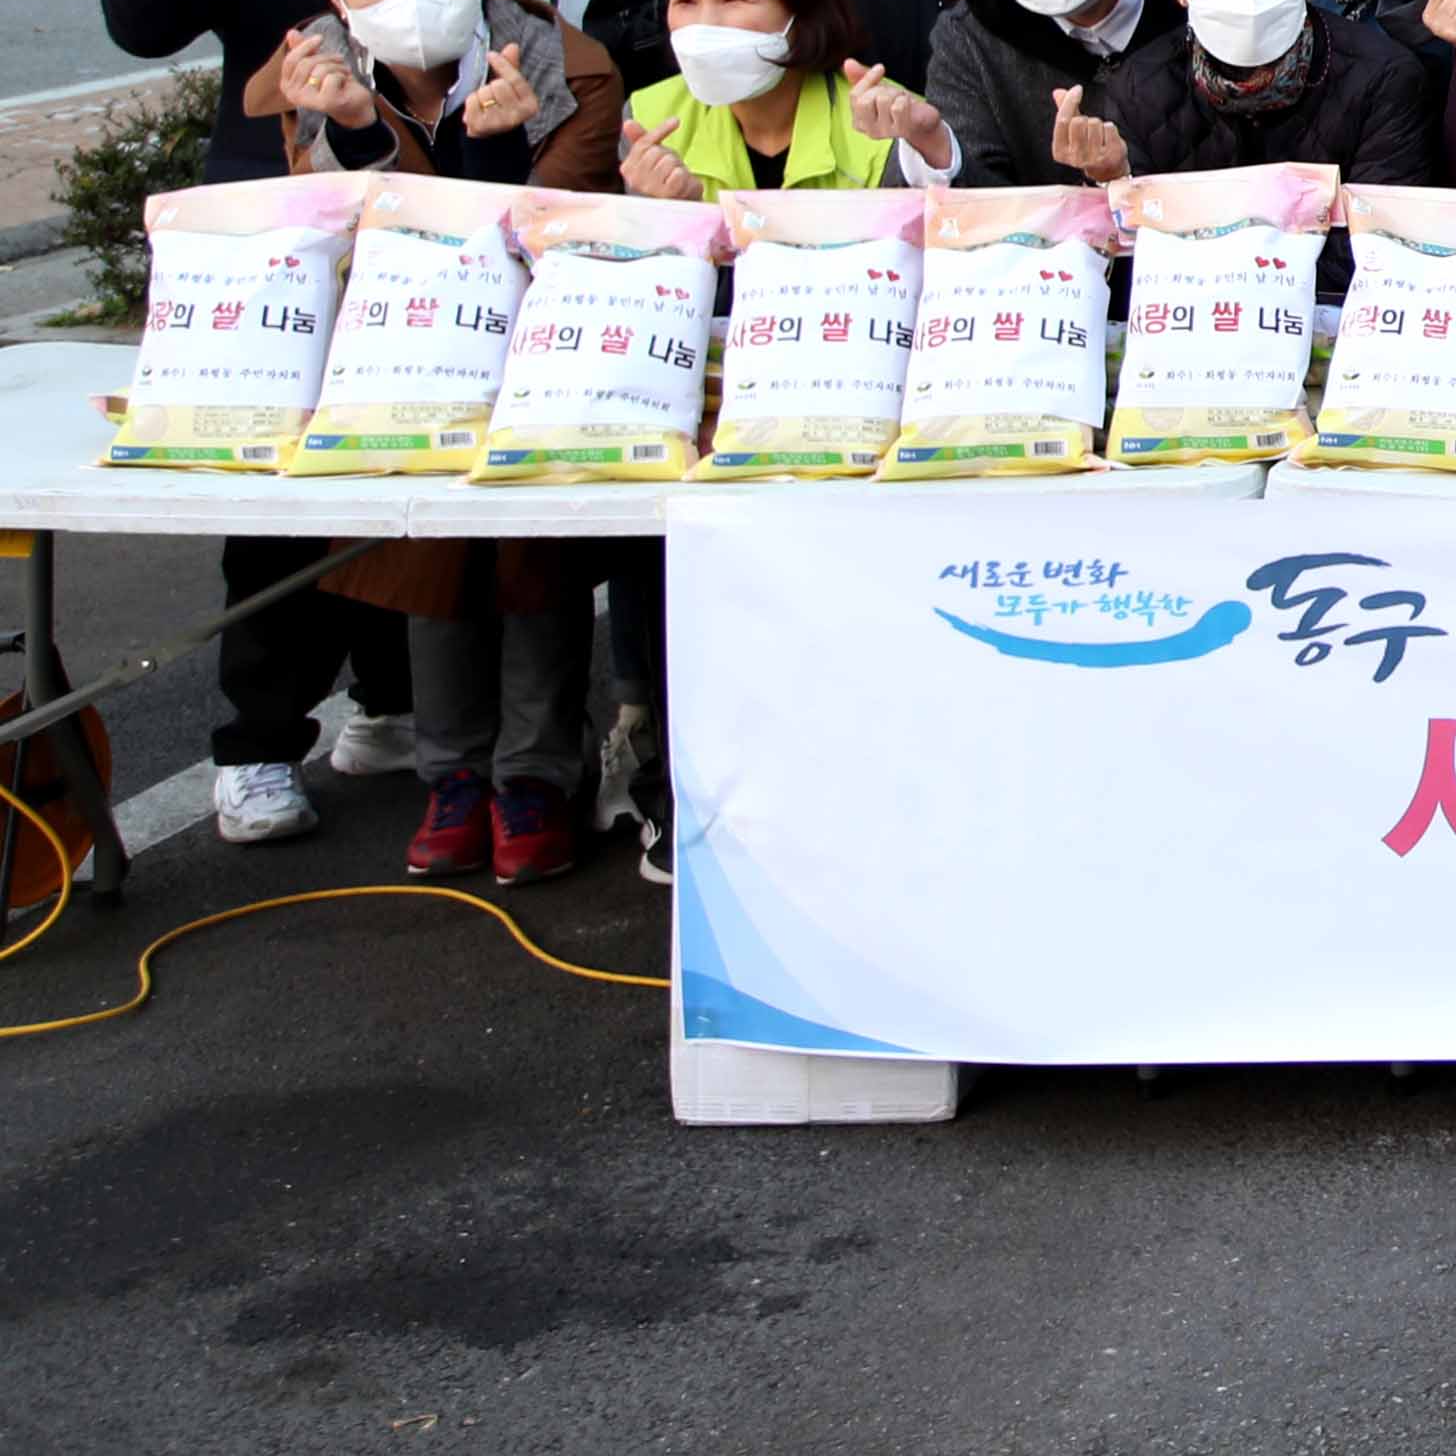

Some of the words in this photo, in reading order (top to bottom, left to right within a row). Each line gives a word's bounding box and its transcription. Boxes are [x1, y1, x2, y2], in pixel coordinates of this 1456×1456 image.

[148, 300, 195, 330] 랑의
[212, 300, 244, 330] 쌀
[261, 304, 317, 334] 나눔
[406, 297, 439, 328] 쌀
[456, 304, 508, 335] 나눔
[821, 311, 853, 342] 쌀
[869, 315, 914, 352] 나눔
[993, 312, 1024, 341] 쌀
[1041, 318, 1087, 349] 나눔
[1211, 301, 1242, 332] 쌀
[1259, 307, 1303, 336] 나눔
[1421, 308, 1453, 340] 쌀
[601, 323, 634, 355] 쌀
[648, 333, 697, 369] 나눔
[938, 560, 1034, 590] 새로운
[1042, 559, 1130, 590] 변화
[993, 592, 1088, 628] 모두가
[1095, 590, 1194, 627] 행복한
[1246, 552, 1449, 684] 동구
